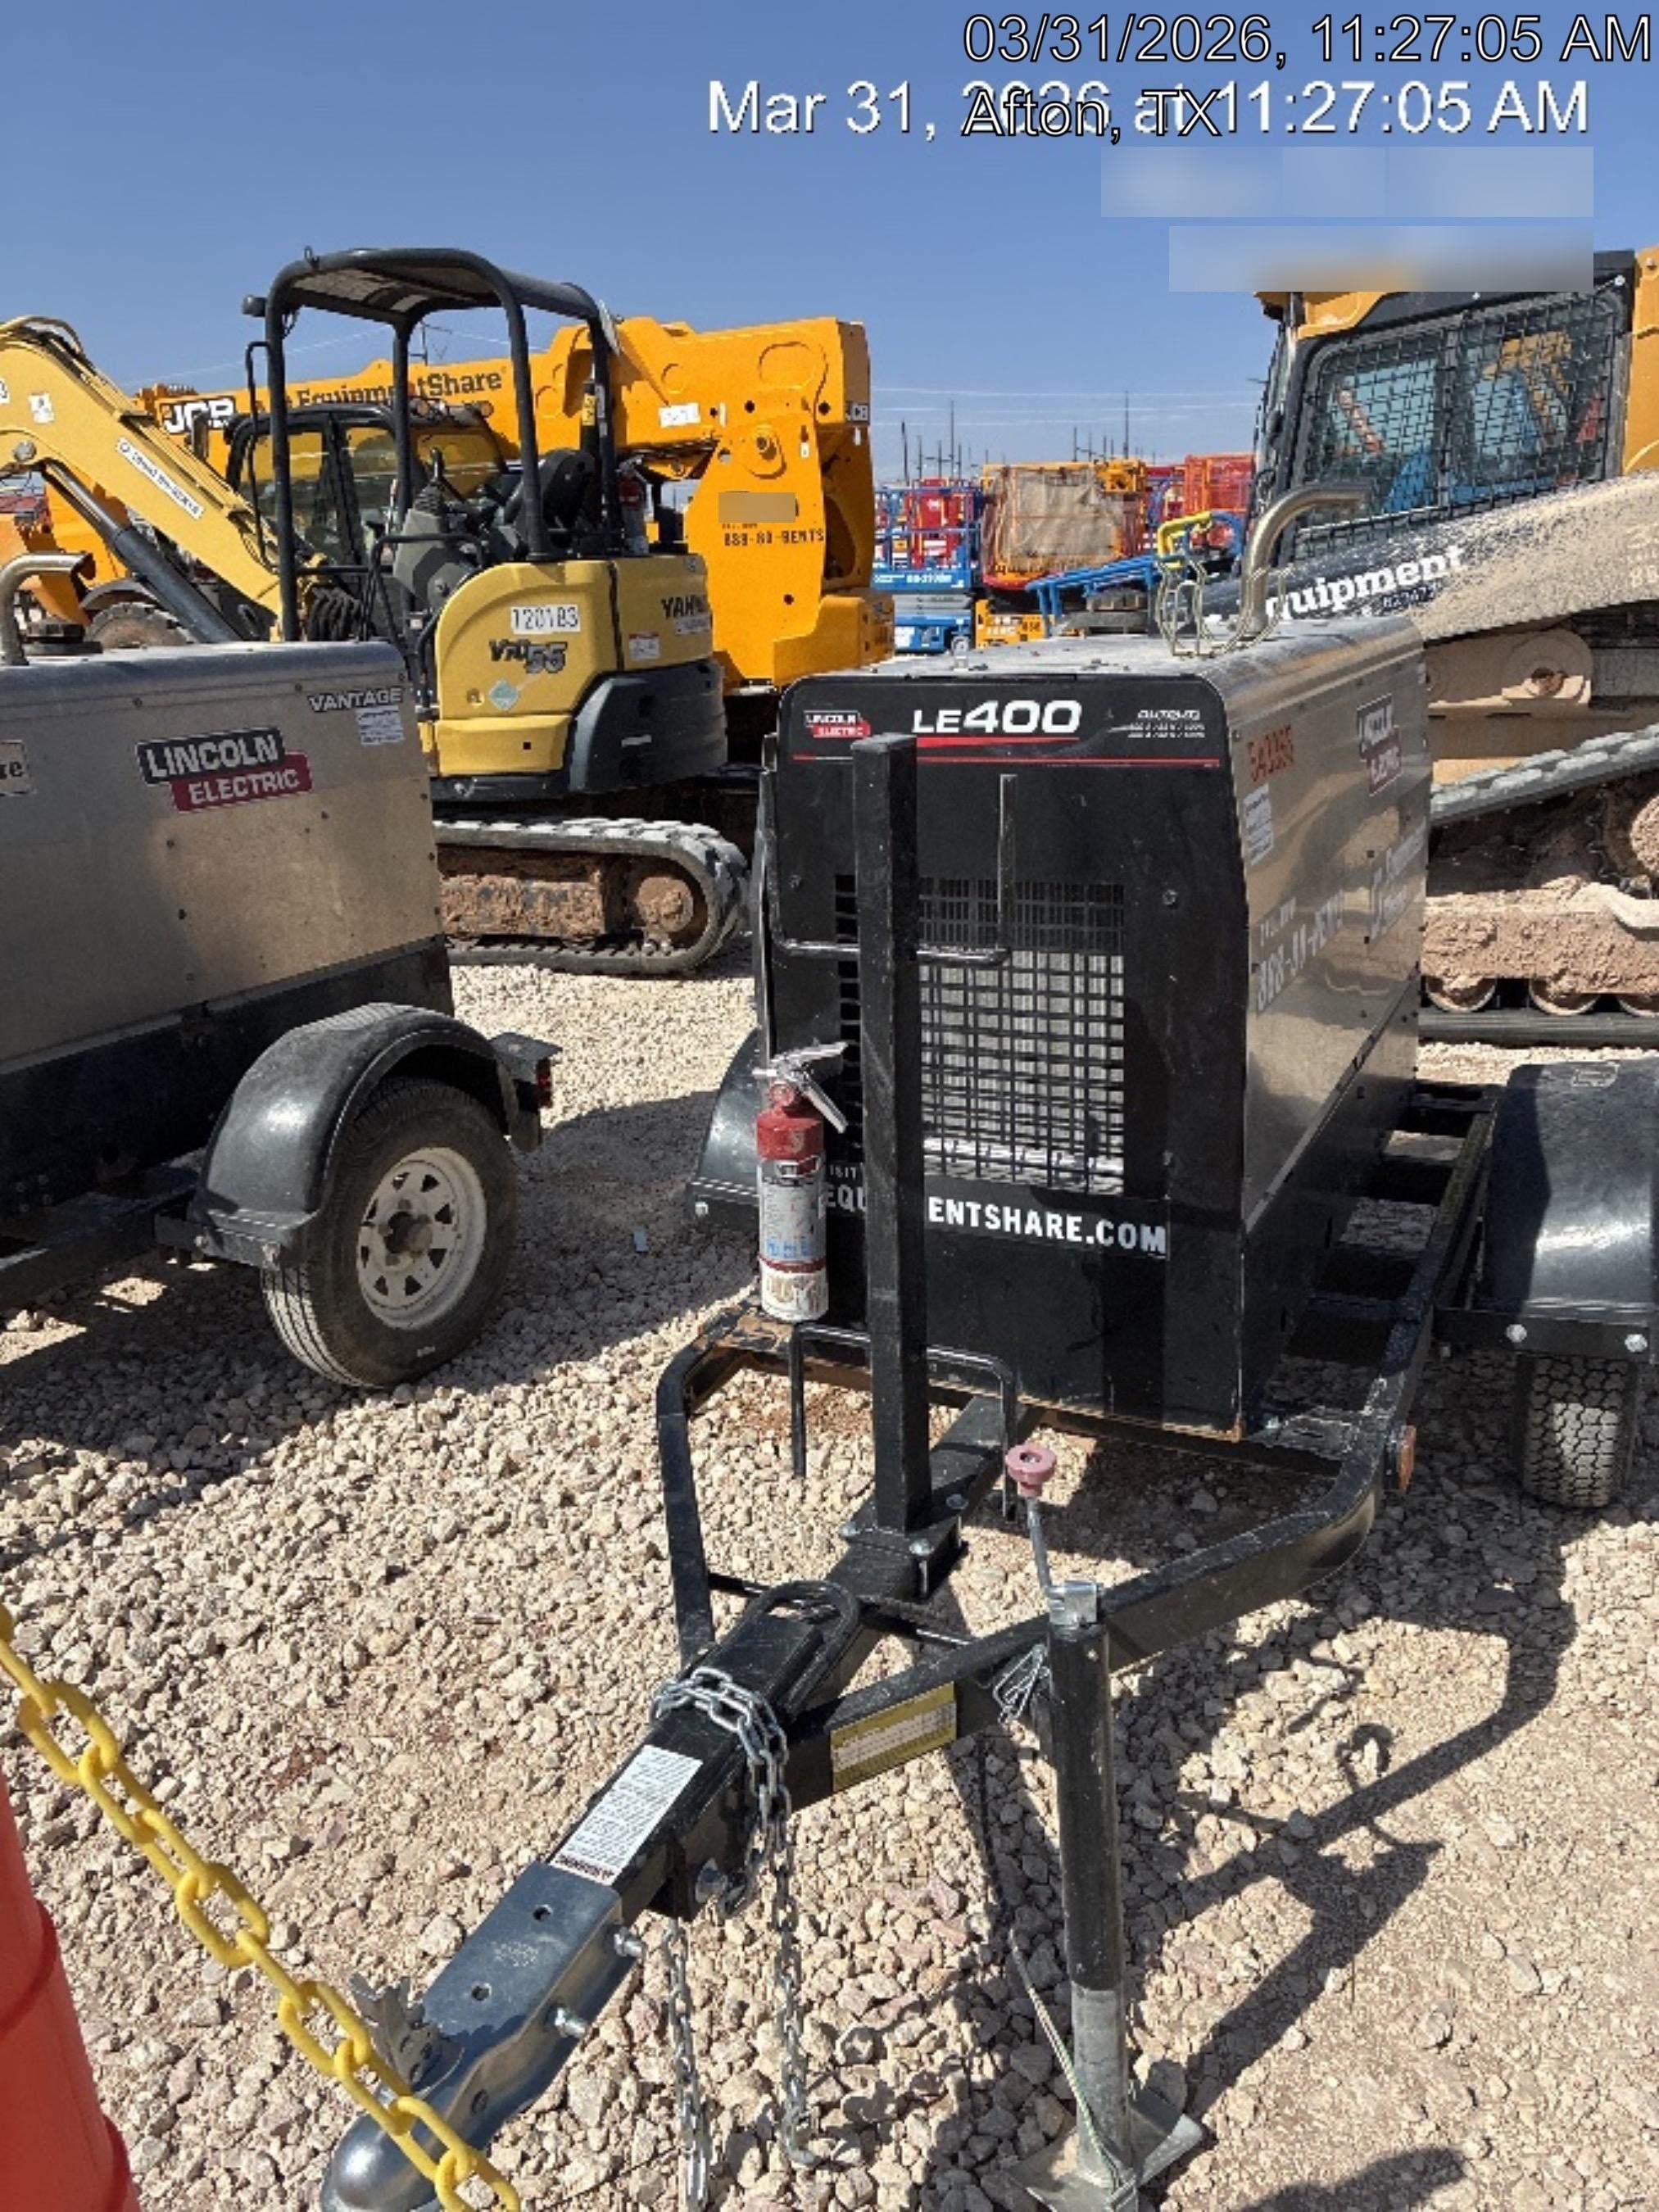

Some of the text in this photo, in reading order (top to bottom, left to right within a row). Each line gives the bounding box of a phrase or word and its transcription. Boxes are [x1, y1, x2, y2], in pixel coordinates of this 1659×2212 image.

[308, 687, 402, 713] VANTAGE
[912, 700, 1083, 734] LE400
[144, 734, 279, 779] LINCOLN
[188, 768, 301, 805] ELECTRIC
